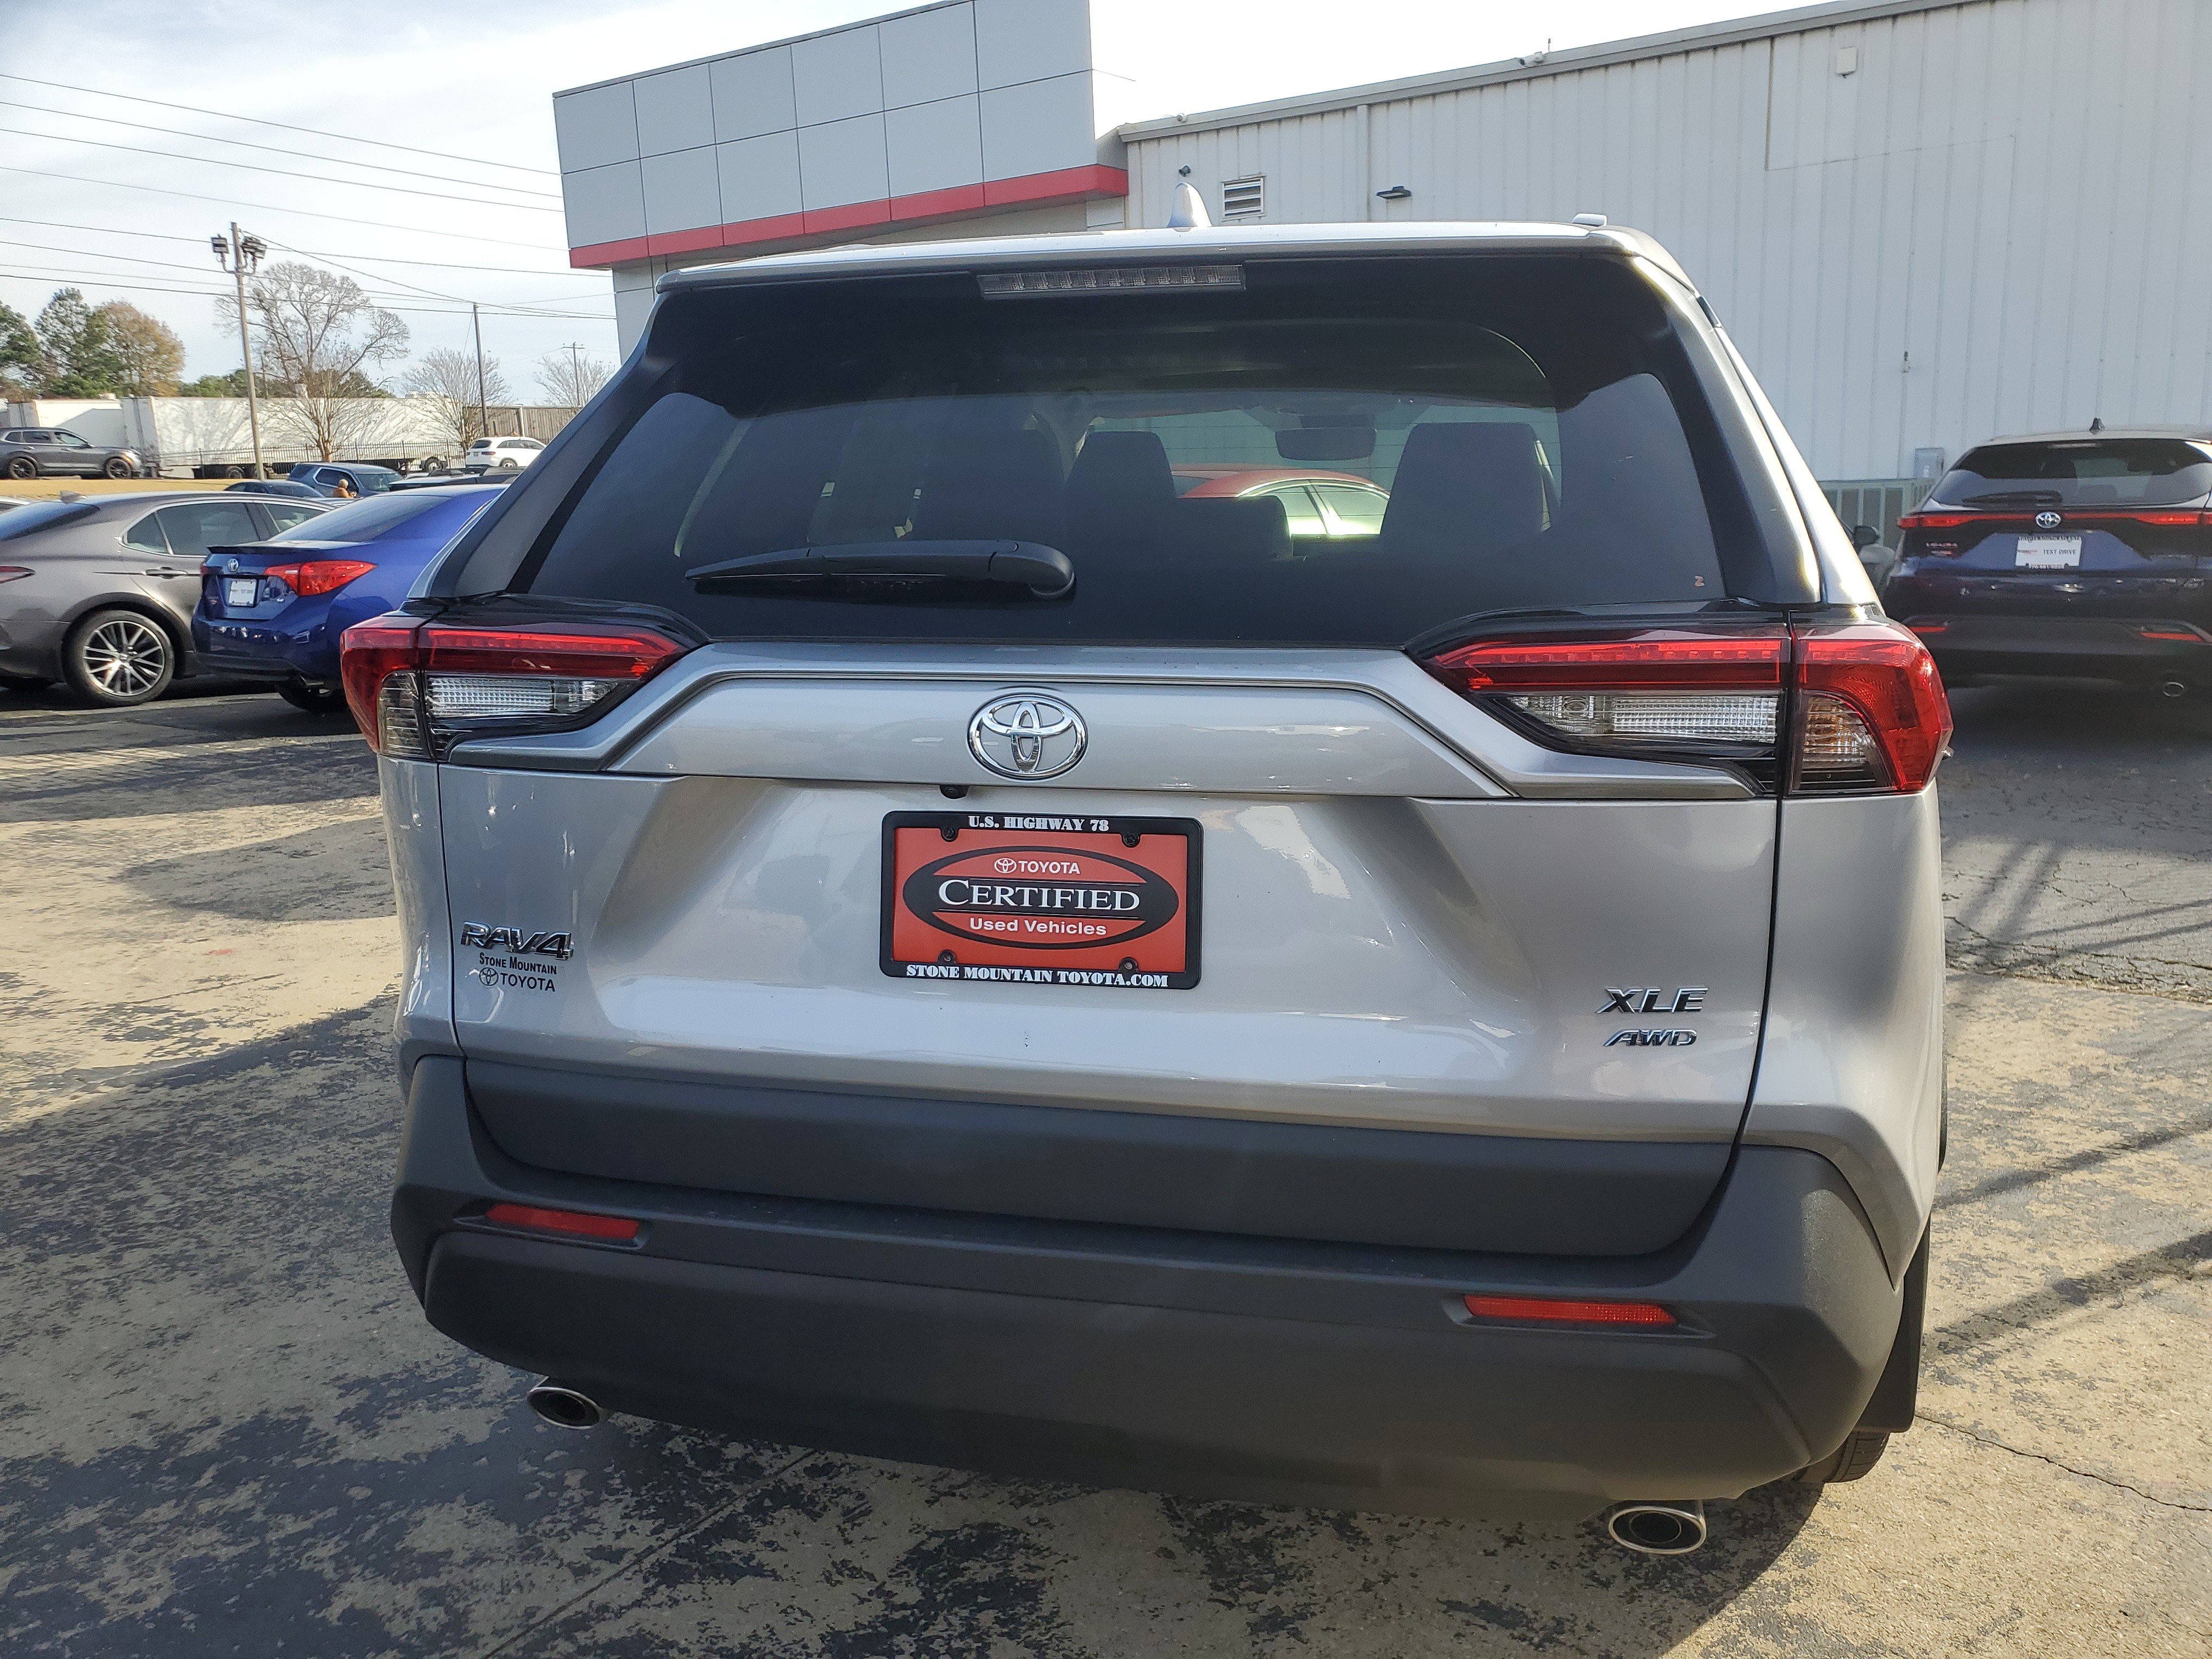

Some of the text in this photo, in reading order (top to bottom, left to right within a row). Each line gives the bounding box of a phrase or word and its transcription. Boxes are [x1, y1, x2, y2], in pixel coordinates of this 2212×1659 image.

[968, 815, 1109, 832] U.S. HIGHWAY 78
[1018, 860, 1081, 874] TOYOTA
[969, 917, 1107, 936] Used Vehicles
[460, 921, 574, 960] RAV4
[479, 952, 557, 975] STONE MOUNTAIN
[500, 972, 556, 992] TOYOTA
[906, 964, 1169, 988] STONE MOUNTAIN TOYOTA.COM
[1595, 987, 1709, 1013] XLE
[1602, 1028, 1697, 1046] AWD
